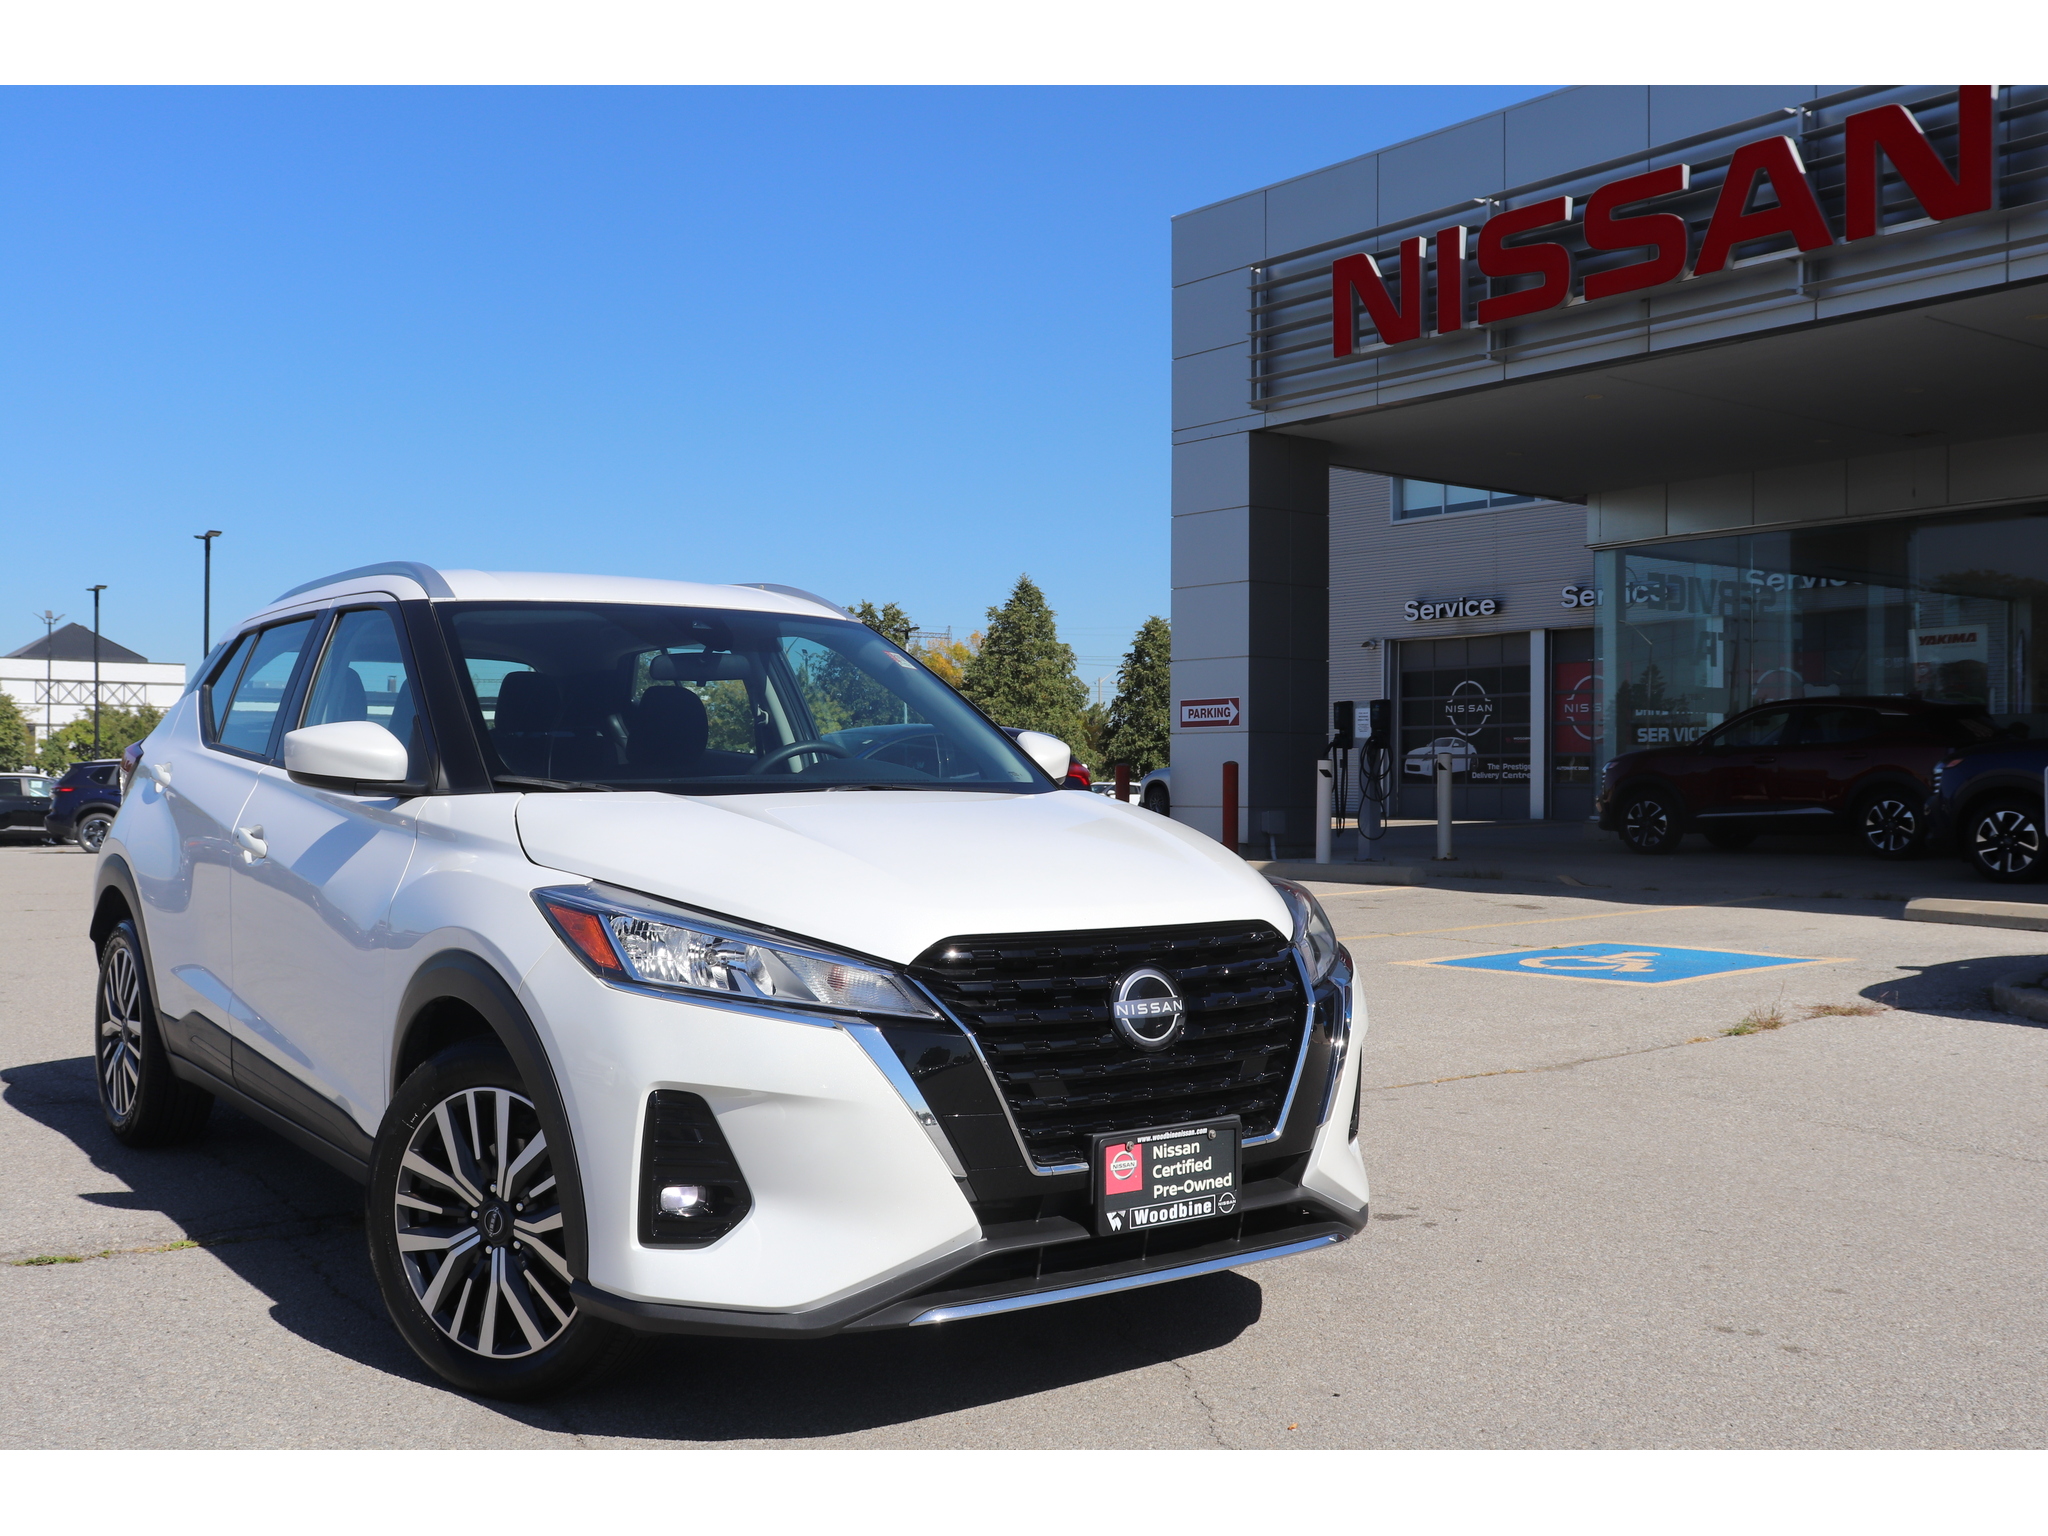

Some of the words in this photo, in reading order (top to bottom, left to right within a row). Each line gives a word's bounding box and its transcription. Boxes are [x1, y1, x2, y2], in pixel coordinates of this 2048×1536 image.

[1333, 85, 1998, 358] NISSAN
[1404, 597, 1496, 622] Service
[1919, 632, 1978, 646] YAKIMA
[1188, 707, 1230, 718] PARKING
[1445, 704, 1493, 713] NISSAN
[1564, 702, 1602, 713] NISS
[1471, 771, 1500, 780] Delivery
[1116, 1000, 1183, 1016] NISSAN
[1137, 1128, 1208, 1143] www.woodbinenissan.com
[1152, 1142, 1200, 1160] Nissan
[1112, 1161, 1136, 1170] NISSAN
[1152, 1156, 1212, 1179] Certified
[1153, 1172, 1233, 1199] Pre-Owned
[1218, 1199, 1237, 1207] NISSAN
[1134, 1200, 1213, 1226] Woodbine
